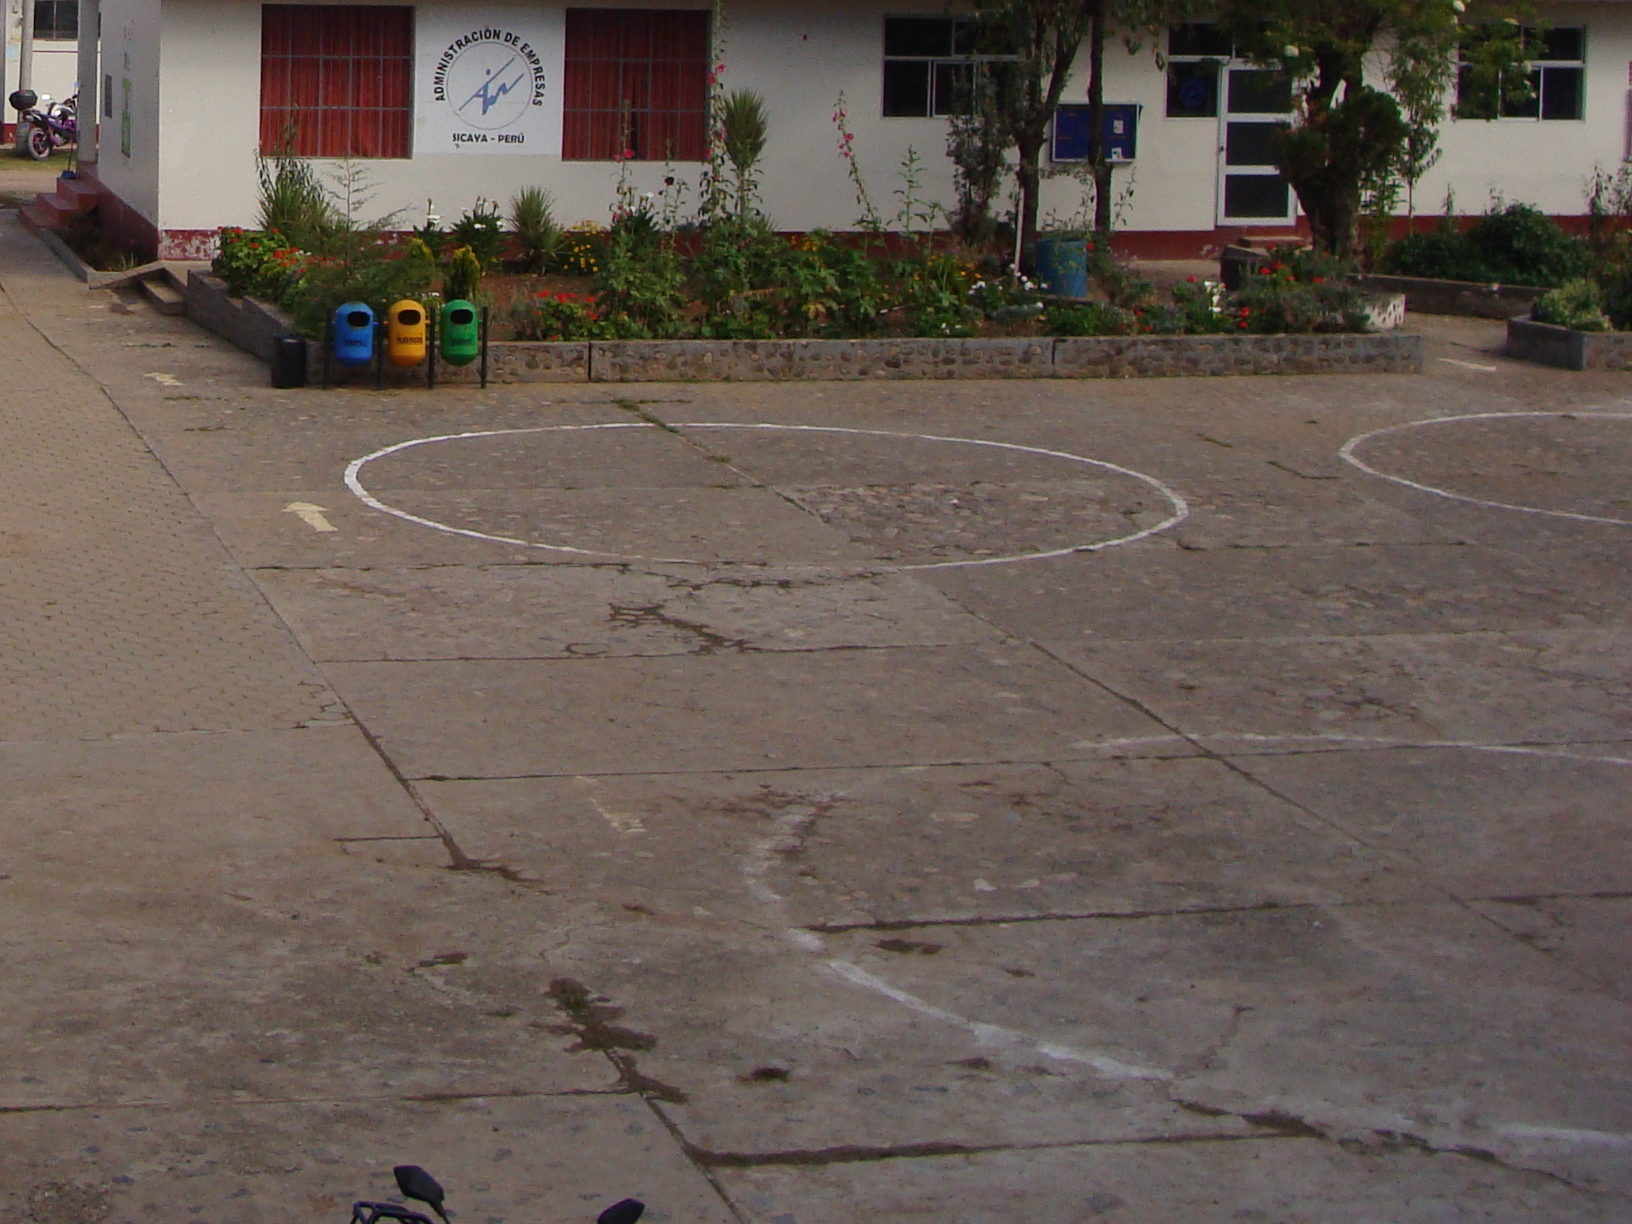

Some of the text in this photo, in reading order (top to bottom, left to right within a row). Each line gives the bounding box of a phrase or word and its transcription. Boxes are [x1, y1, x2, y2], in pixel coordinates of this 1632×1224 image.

[433, 26, 546, 107] ADMINISTRACIÓN DE EMPRESAS
[452, 133, 488, 143] SICAYA
[498, 132, 525, 144] PERÚ
